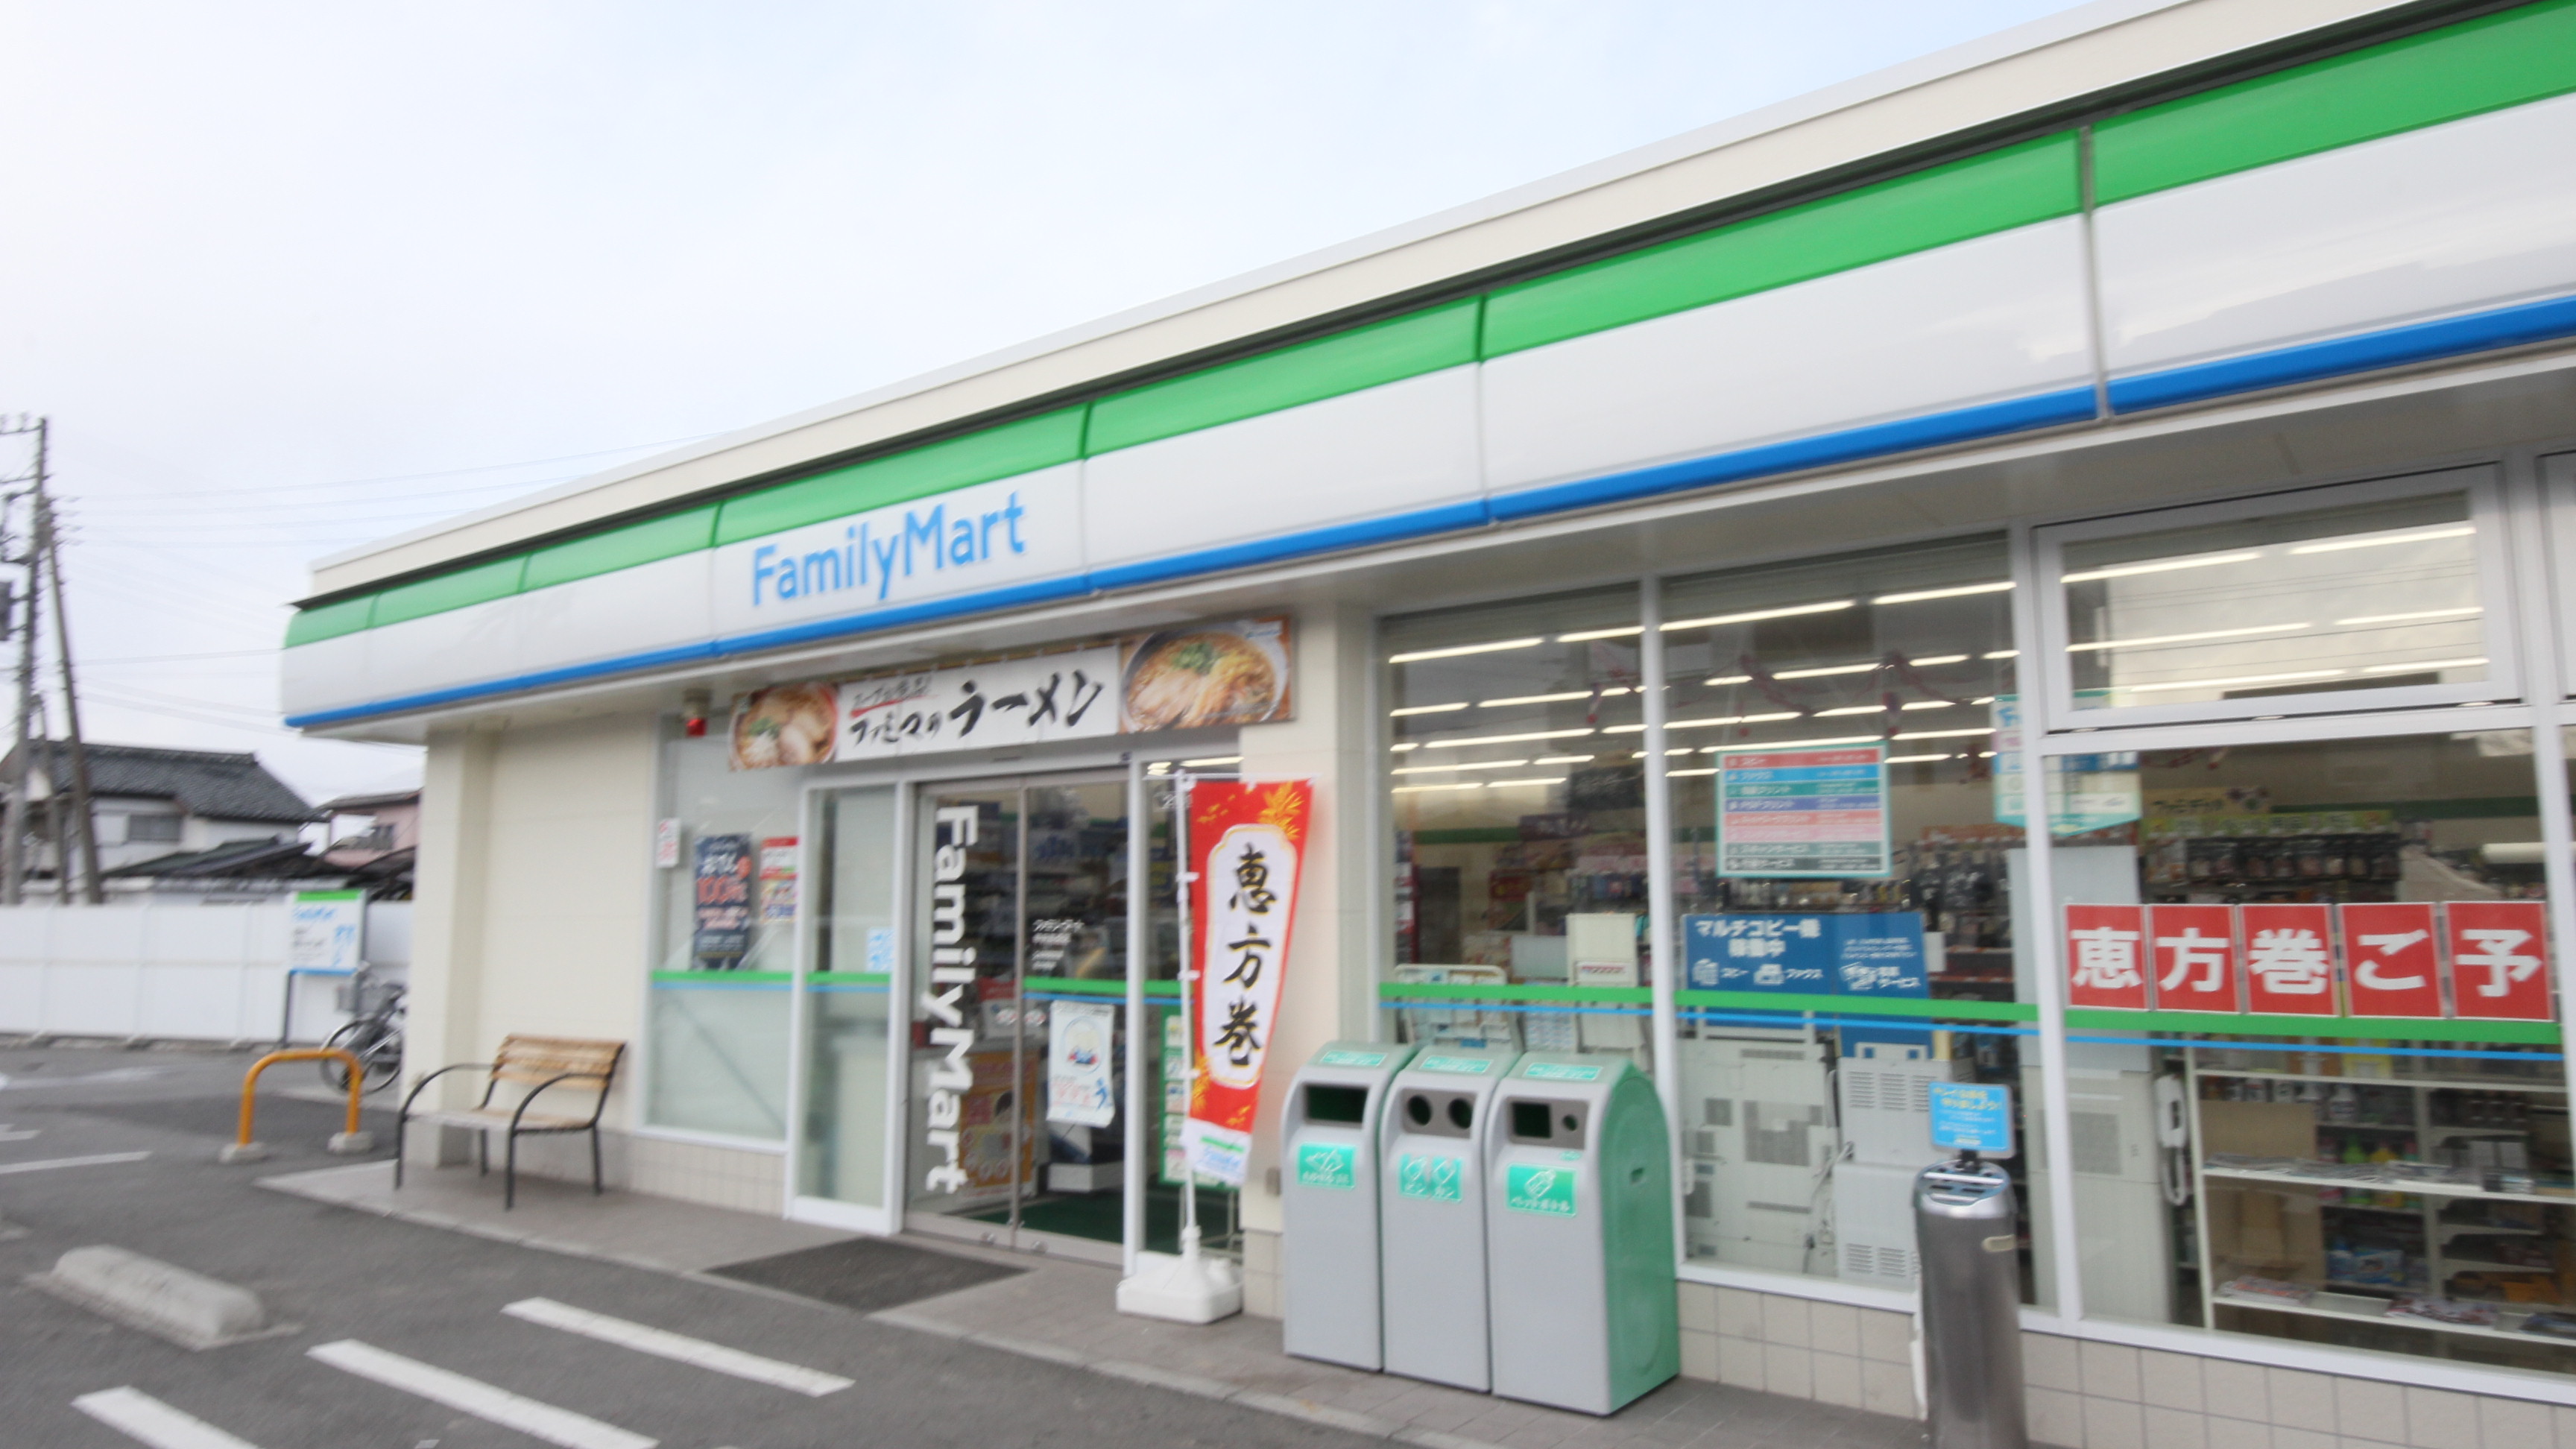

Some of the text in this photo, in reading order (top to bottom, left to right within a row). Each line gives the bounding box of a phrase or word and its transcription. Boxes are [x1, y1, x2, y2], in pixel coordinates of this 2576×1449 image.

[752, 490, 1028, 604] FamilyMart
[921, 804, 979, 1193] FamilyMart
[1213, 843, 1278, 1066] 恵方巻
[2070, 926, 2543, 997] 恵方巻ご予
